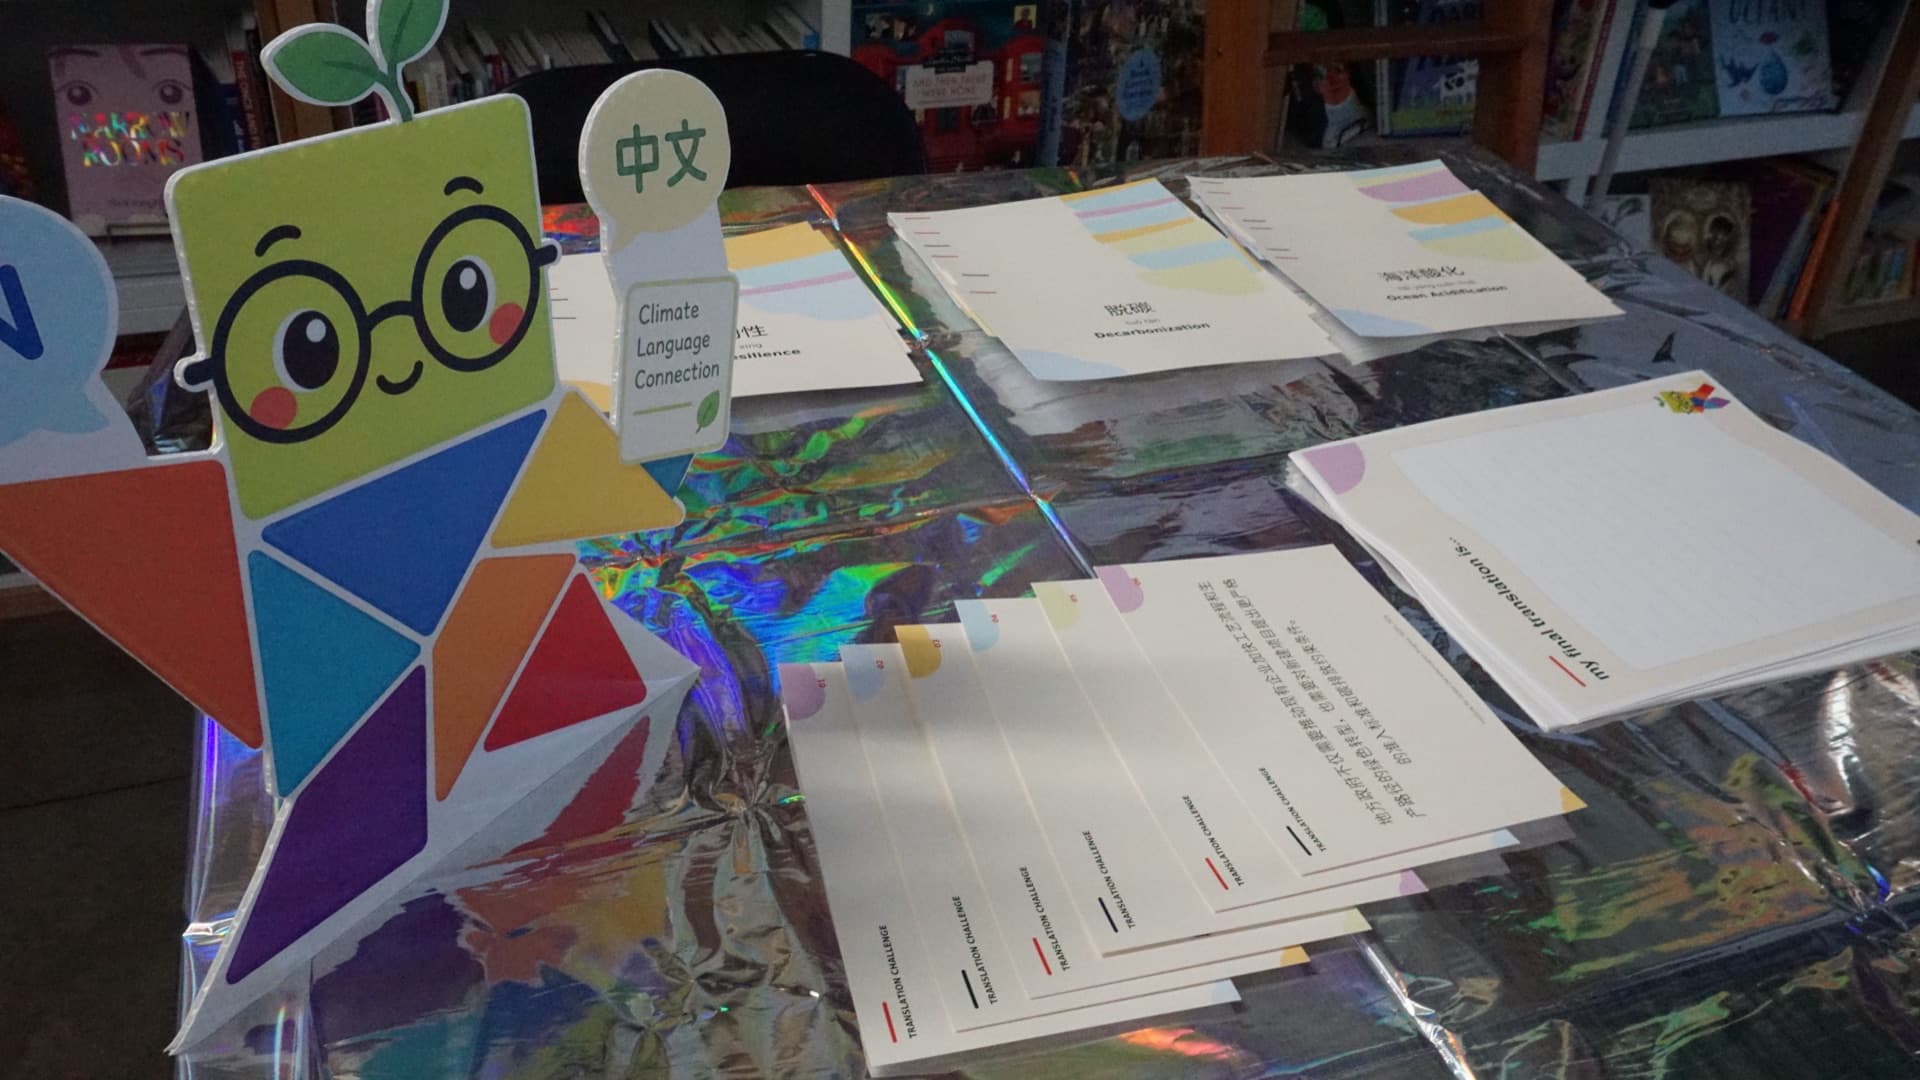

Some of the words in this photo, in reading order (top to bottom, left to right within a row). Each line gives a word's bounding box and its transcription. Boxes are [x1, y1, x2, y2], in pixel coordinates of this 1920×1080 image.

[82, 134, 186, 167] ROOMS
[616, 118, 707, 194] 中文
[639, 302, 699, 325] Climate
[1386, 293, 1429, 301] Ocean
[1430, 285, 1509, 298] Acidification
[637, 332, 710, 359] Language
[736, 325, 769, 339] 性
[1094, 323, 1210, 339] Decarbonization
[635, 361, 720, 389] Connection
[1469, 557, 1547, 628] translation
[1540, 628, 1582, 659] final
[1580, 660, 1610, 681] my
[1258, 767, 1291, 806] CHALLENGE
[1182, 795, 1212, 837] CHALLENGE
[1288, 806, 1327, 852] TRANSLATION
[1082, 830, 1108, 875] CHALLENGE
[1208, 836, 1245, 887] TRANSLATION
[1020, 866, 1044, 913] CHALLENGE
[1103, 875, 1136, 929] TRANSLATION
[952, 895, 976, 945] CHALLENGE
[878, 924, 900, 976] CHALLENGE
[1039, 914, 1071, 972] TRANSLATION
[969, 945, 999, 1005] TRANSLATION
[892, 977, 918, 1039] TRANSLATION
